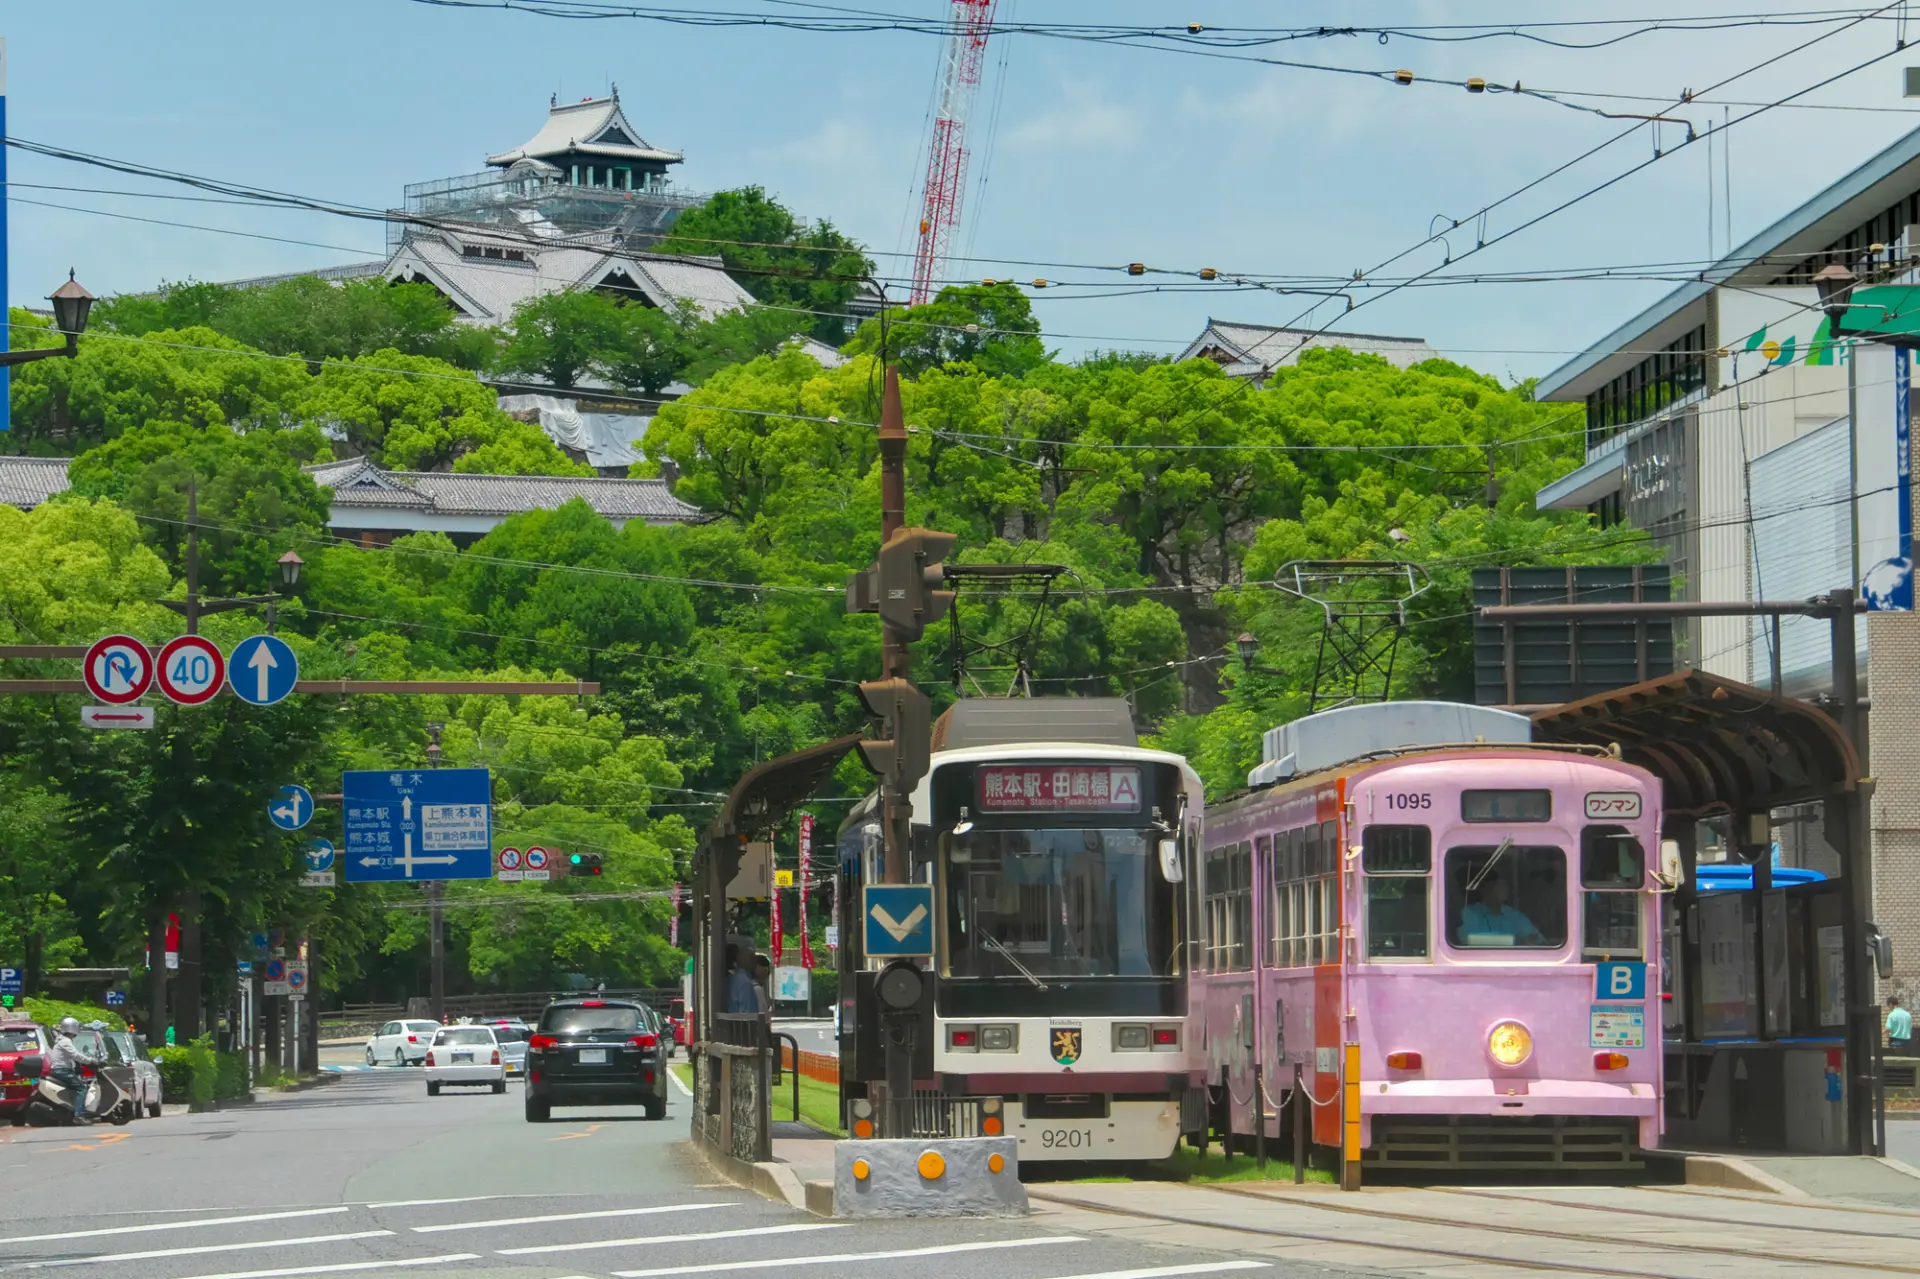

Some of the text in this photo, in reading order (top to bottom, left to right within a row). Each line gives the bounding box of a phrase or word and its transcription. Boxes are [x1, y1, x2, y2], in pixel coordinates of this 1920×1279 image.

[172, 655, 209, 684] 40
[1114, 775, 1136, 801] A
[986, 798, 1025, 806] Kumamoto
[1030, 798, 1058, 806] Station
[1385, 793, 1432, 809] 1095
[1588, 800, 1637, 812] ワンマン
[348, 807, 390, 820] 熊本駅
[427, 806, 482, 821] 上熊本駅
[1610, 966, 1632, 995] B
[1050, 1019, 1082, 1027] Heidelberg
[1042, 1130, 1092, 1148] 9201
